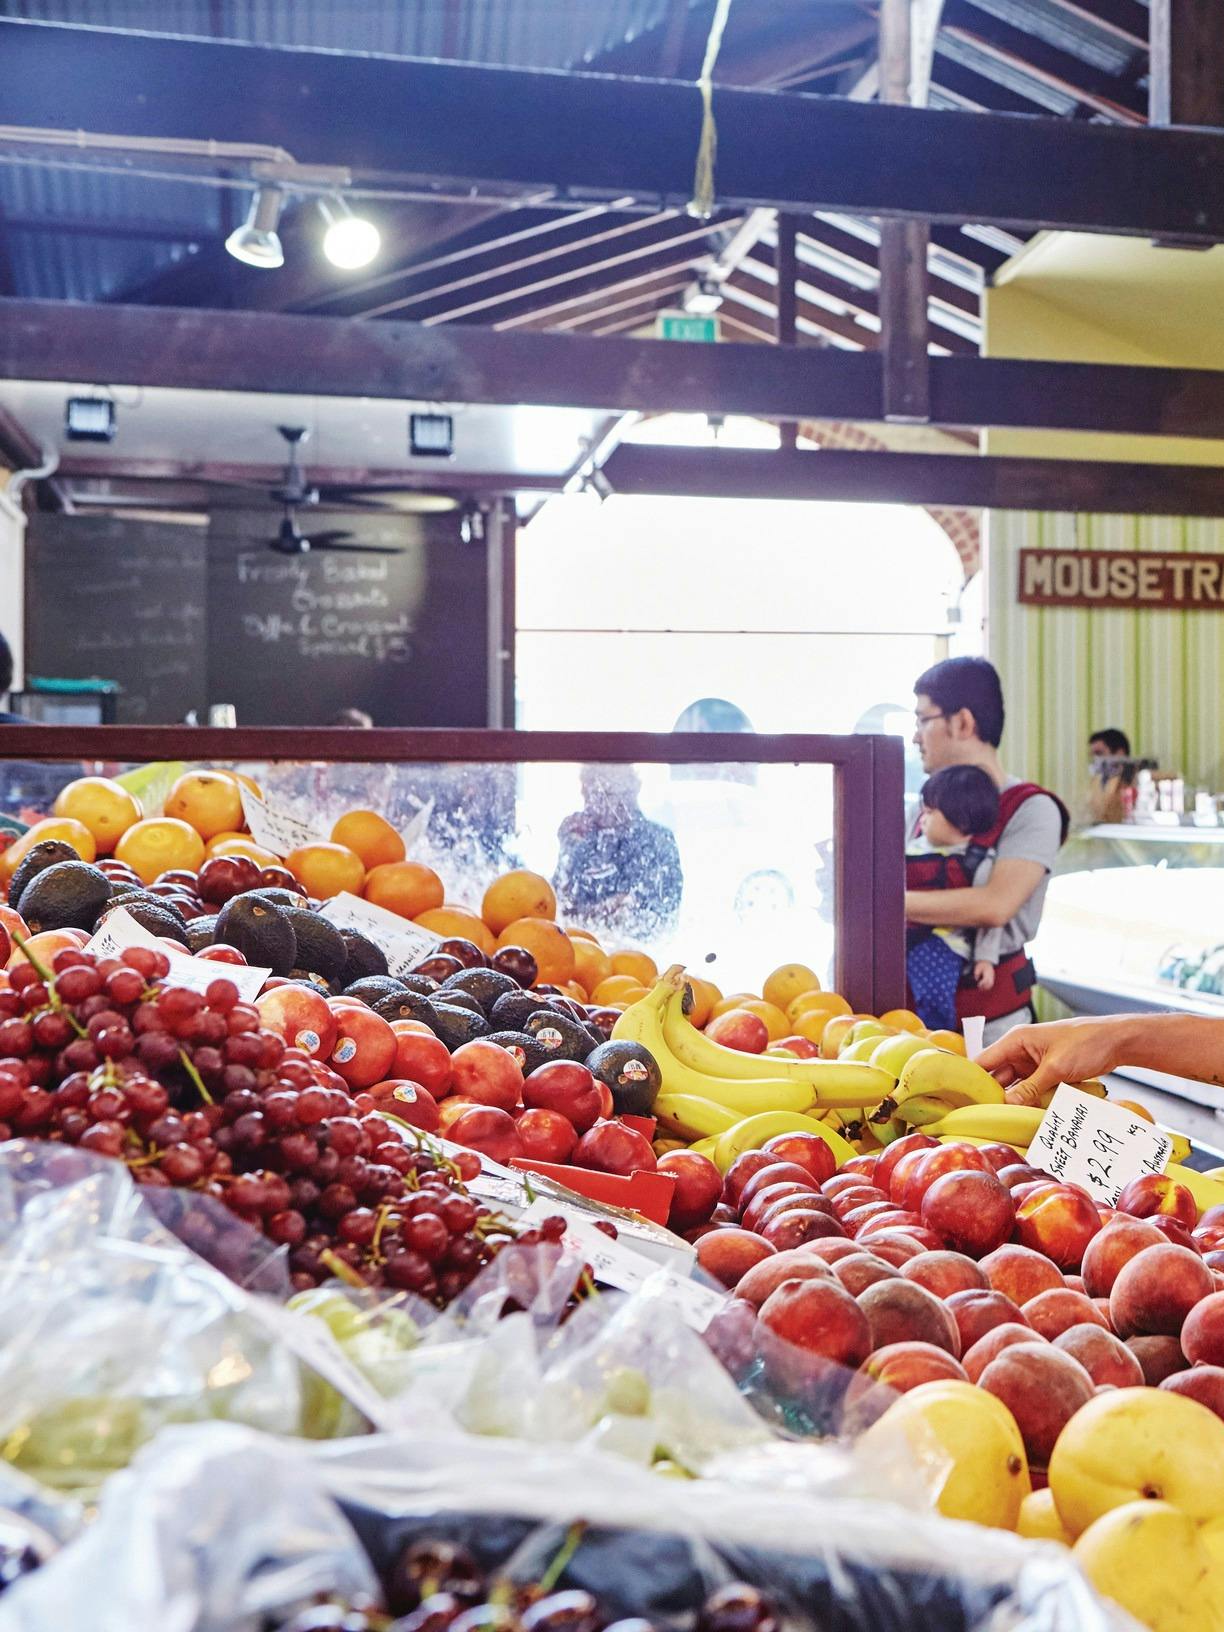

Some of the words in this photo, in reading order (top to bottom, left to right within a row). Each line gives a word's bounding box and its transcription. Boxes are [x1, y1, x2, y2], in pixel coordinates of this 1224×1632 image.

[1050, 1147, 1072, 1177] SWEET
[1061, 1104, 1088, 1149] BANANAS
[1087, 1129, 1125, 1188] $2.99
